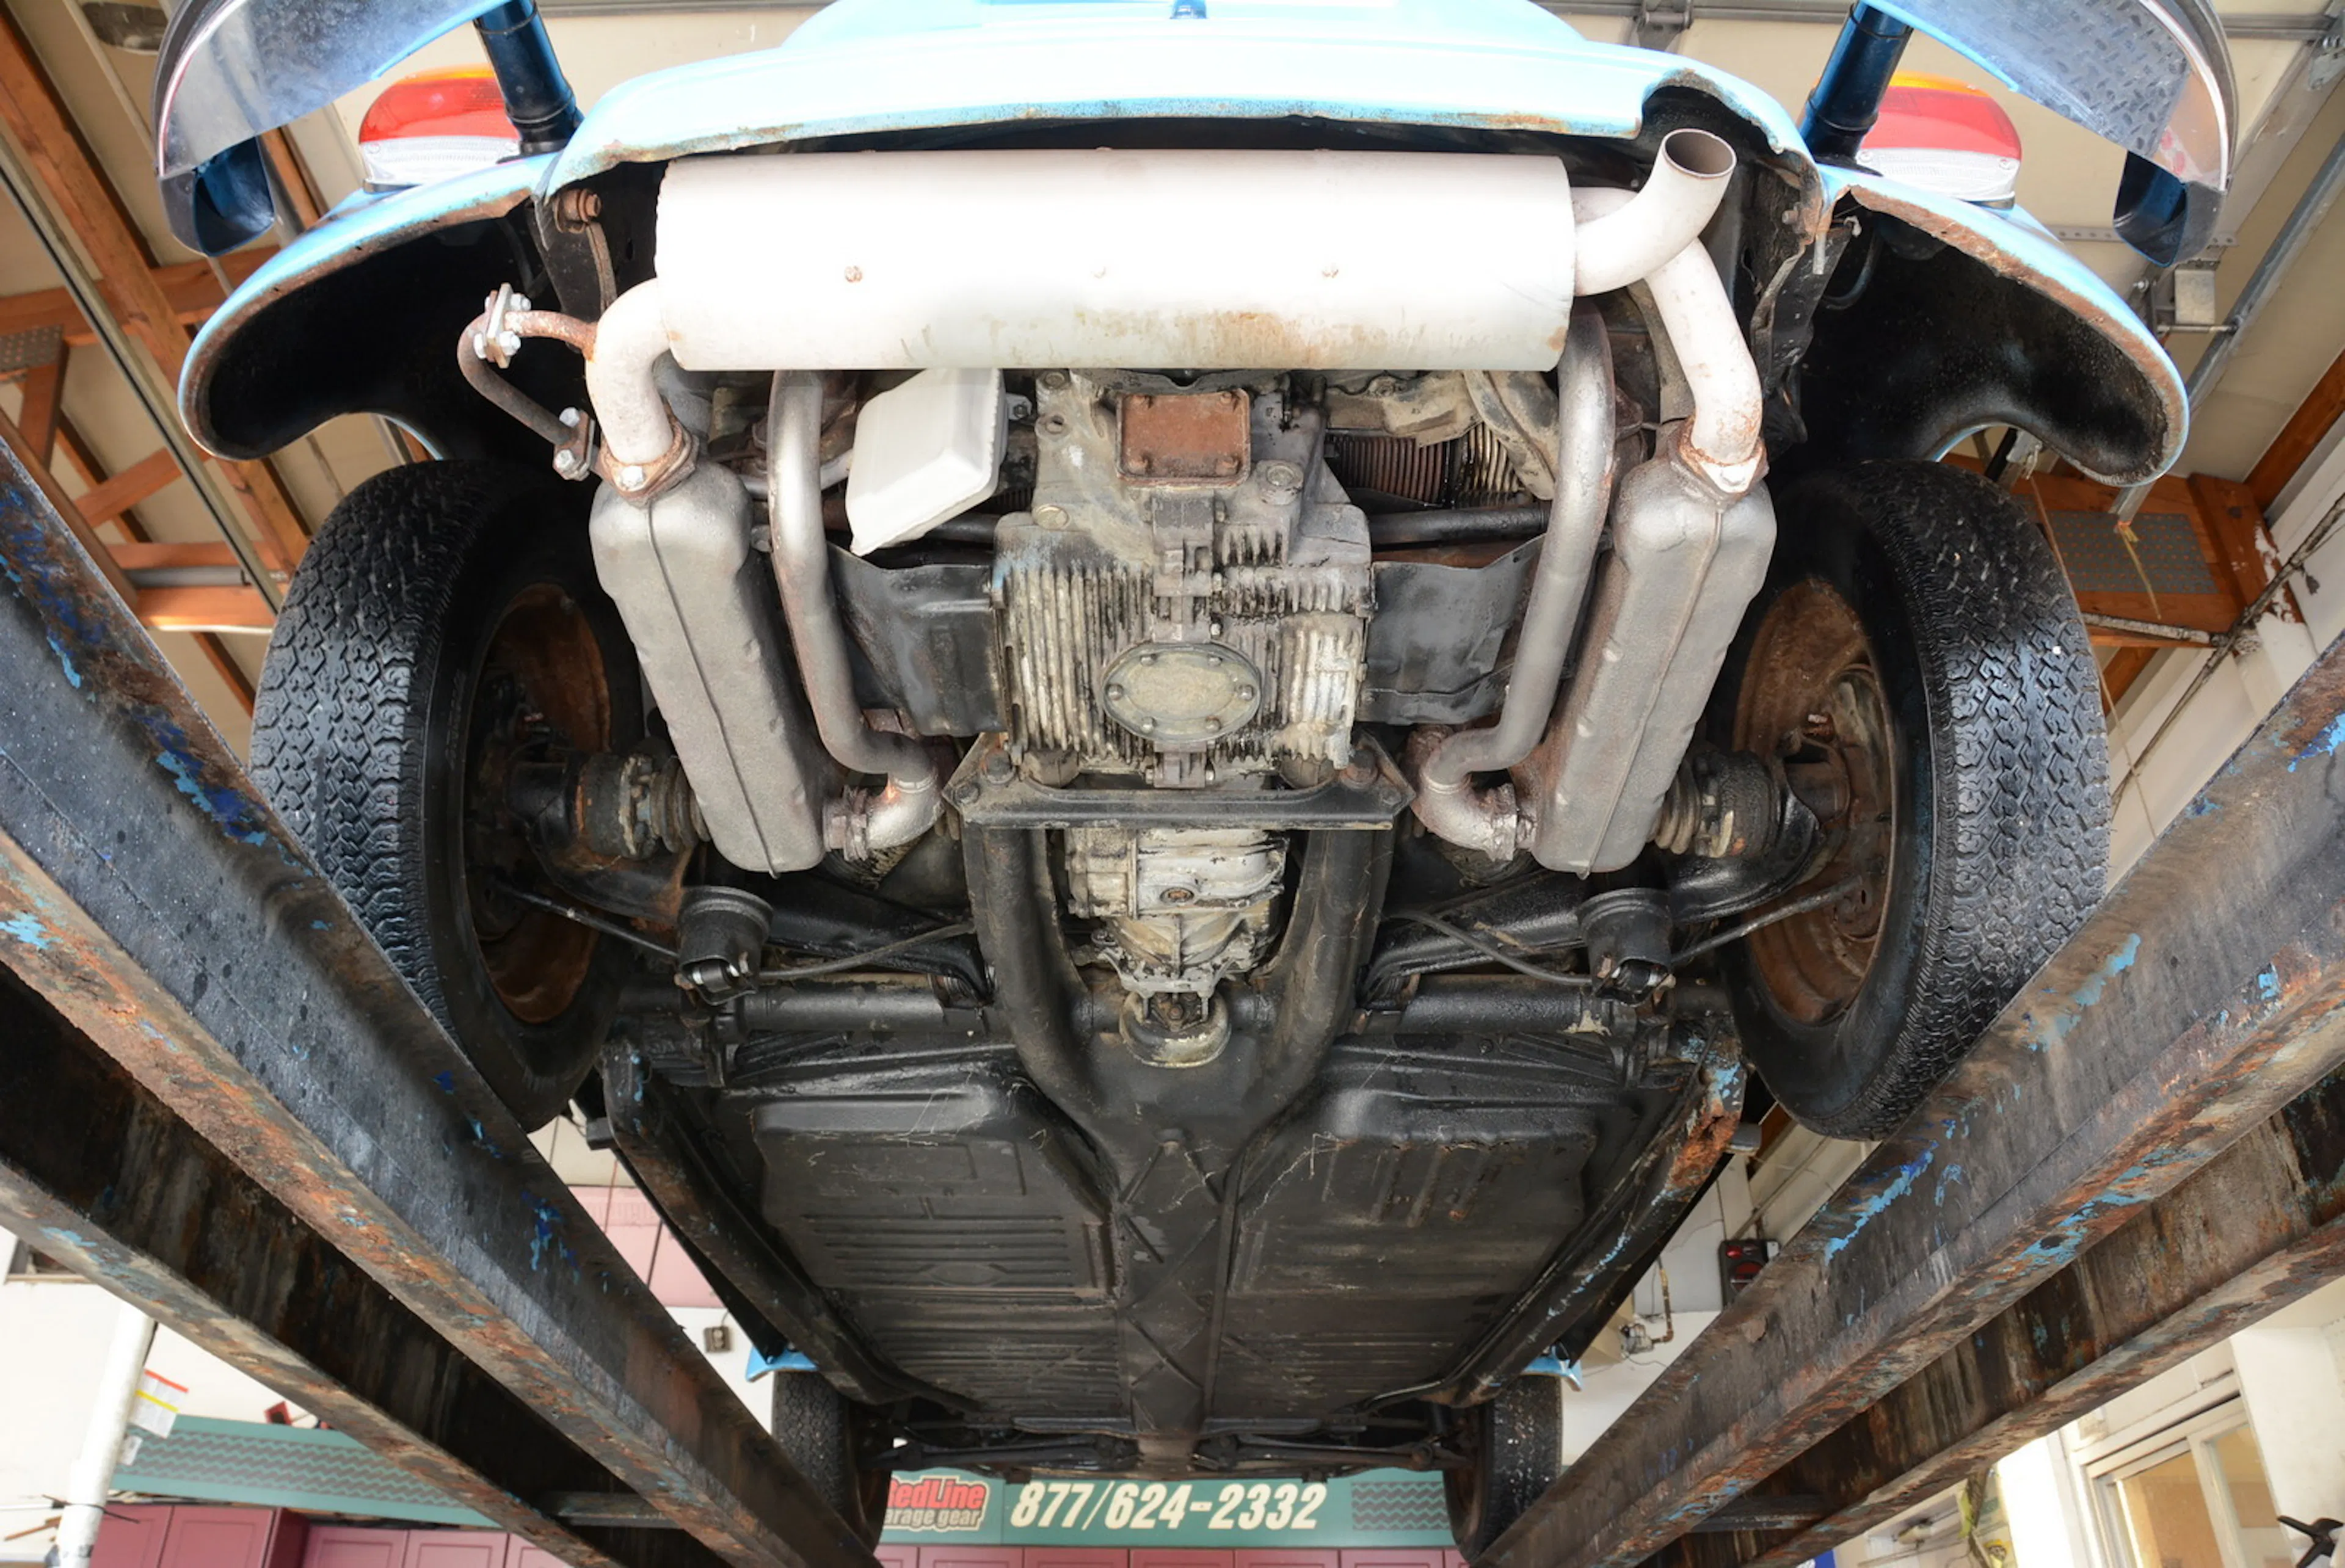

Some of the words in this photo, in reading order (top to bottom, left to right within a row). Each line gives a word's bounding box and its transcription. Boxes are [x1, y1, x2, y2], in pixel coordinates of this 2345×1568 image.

[884, 1508, 934, 1527] arage
[937, 1509, 981, 1527] gear
[1010, 1481, 1327, 1531] 877/624-2332
